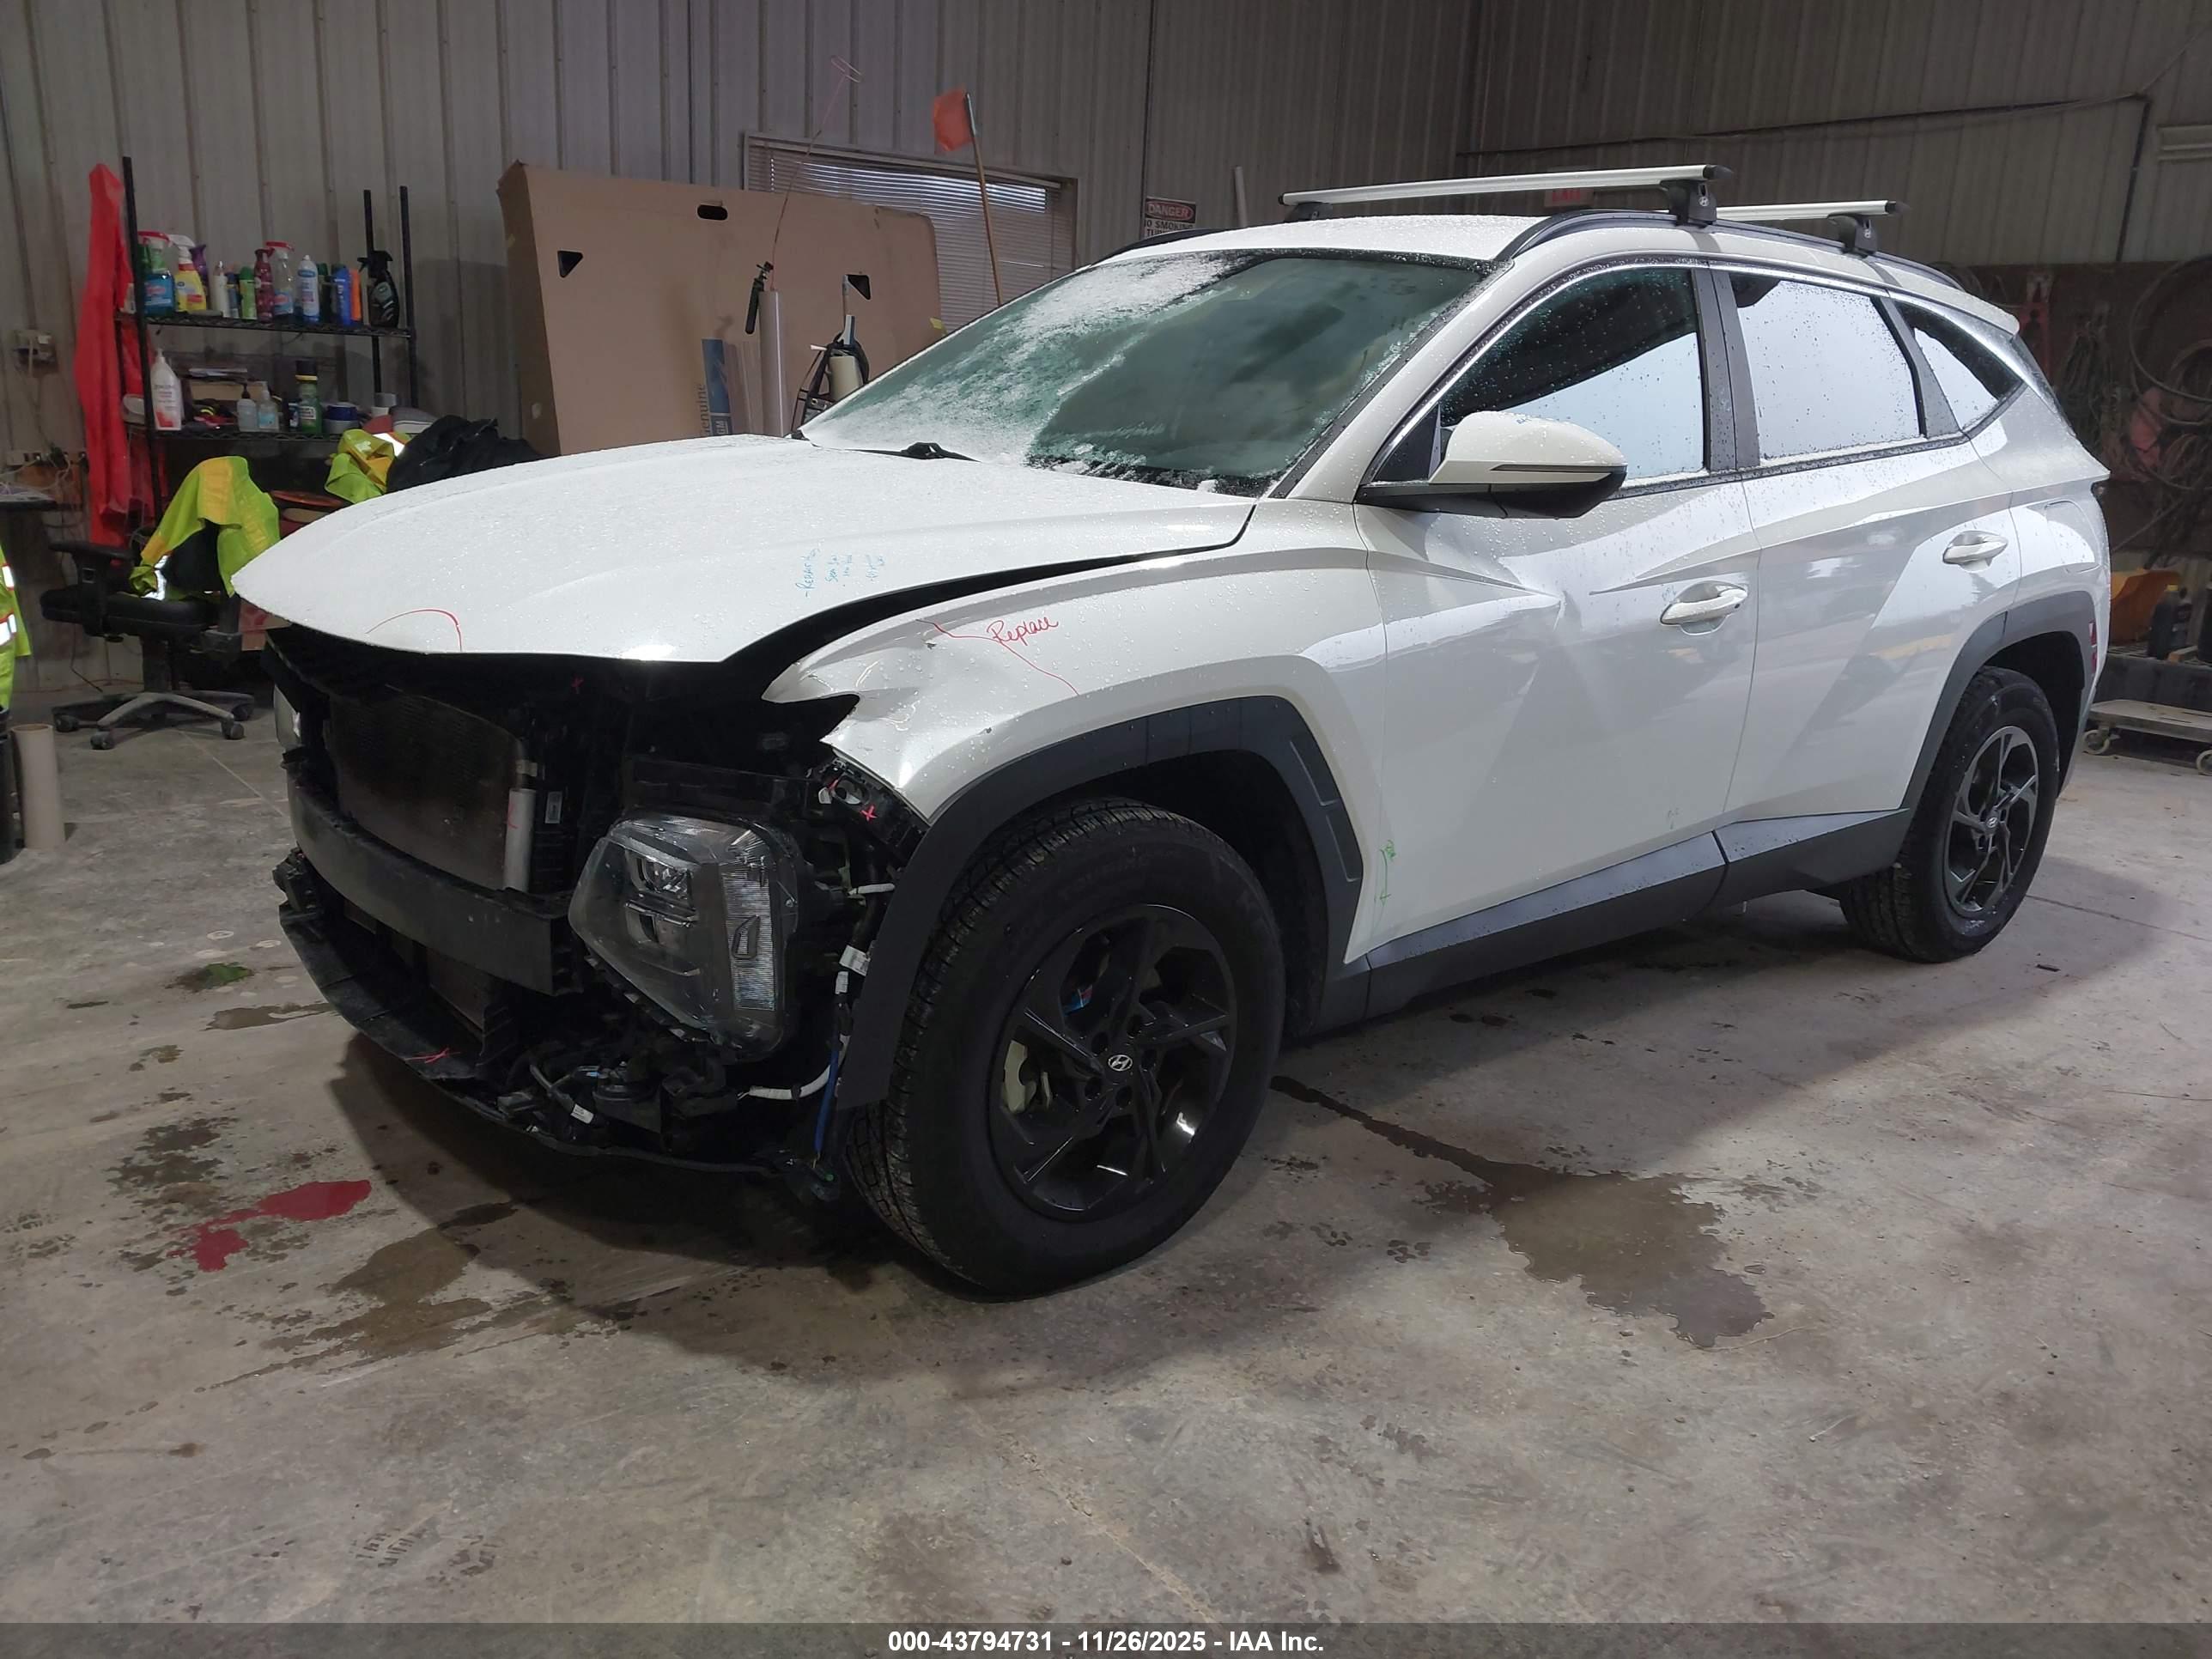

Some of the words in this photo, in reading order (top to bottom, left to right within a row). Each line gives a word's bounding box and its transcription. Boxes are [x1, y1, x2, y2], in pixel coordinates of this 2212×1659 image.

[1147, 204, 1189, 217] DANGER
[698, 384, 711, 434] enuine
[987, 616, 1060, 646] Replace
